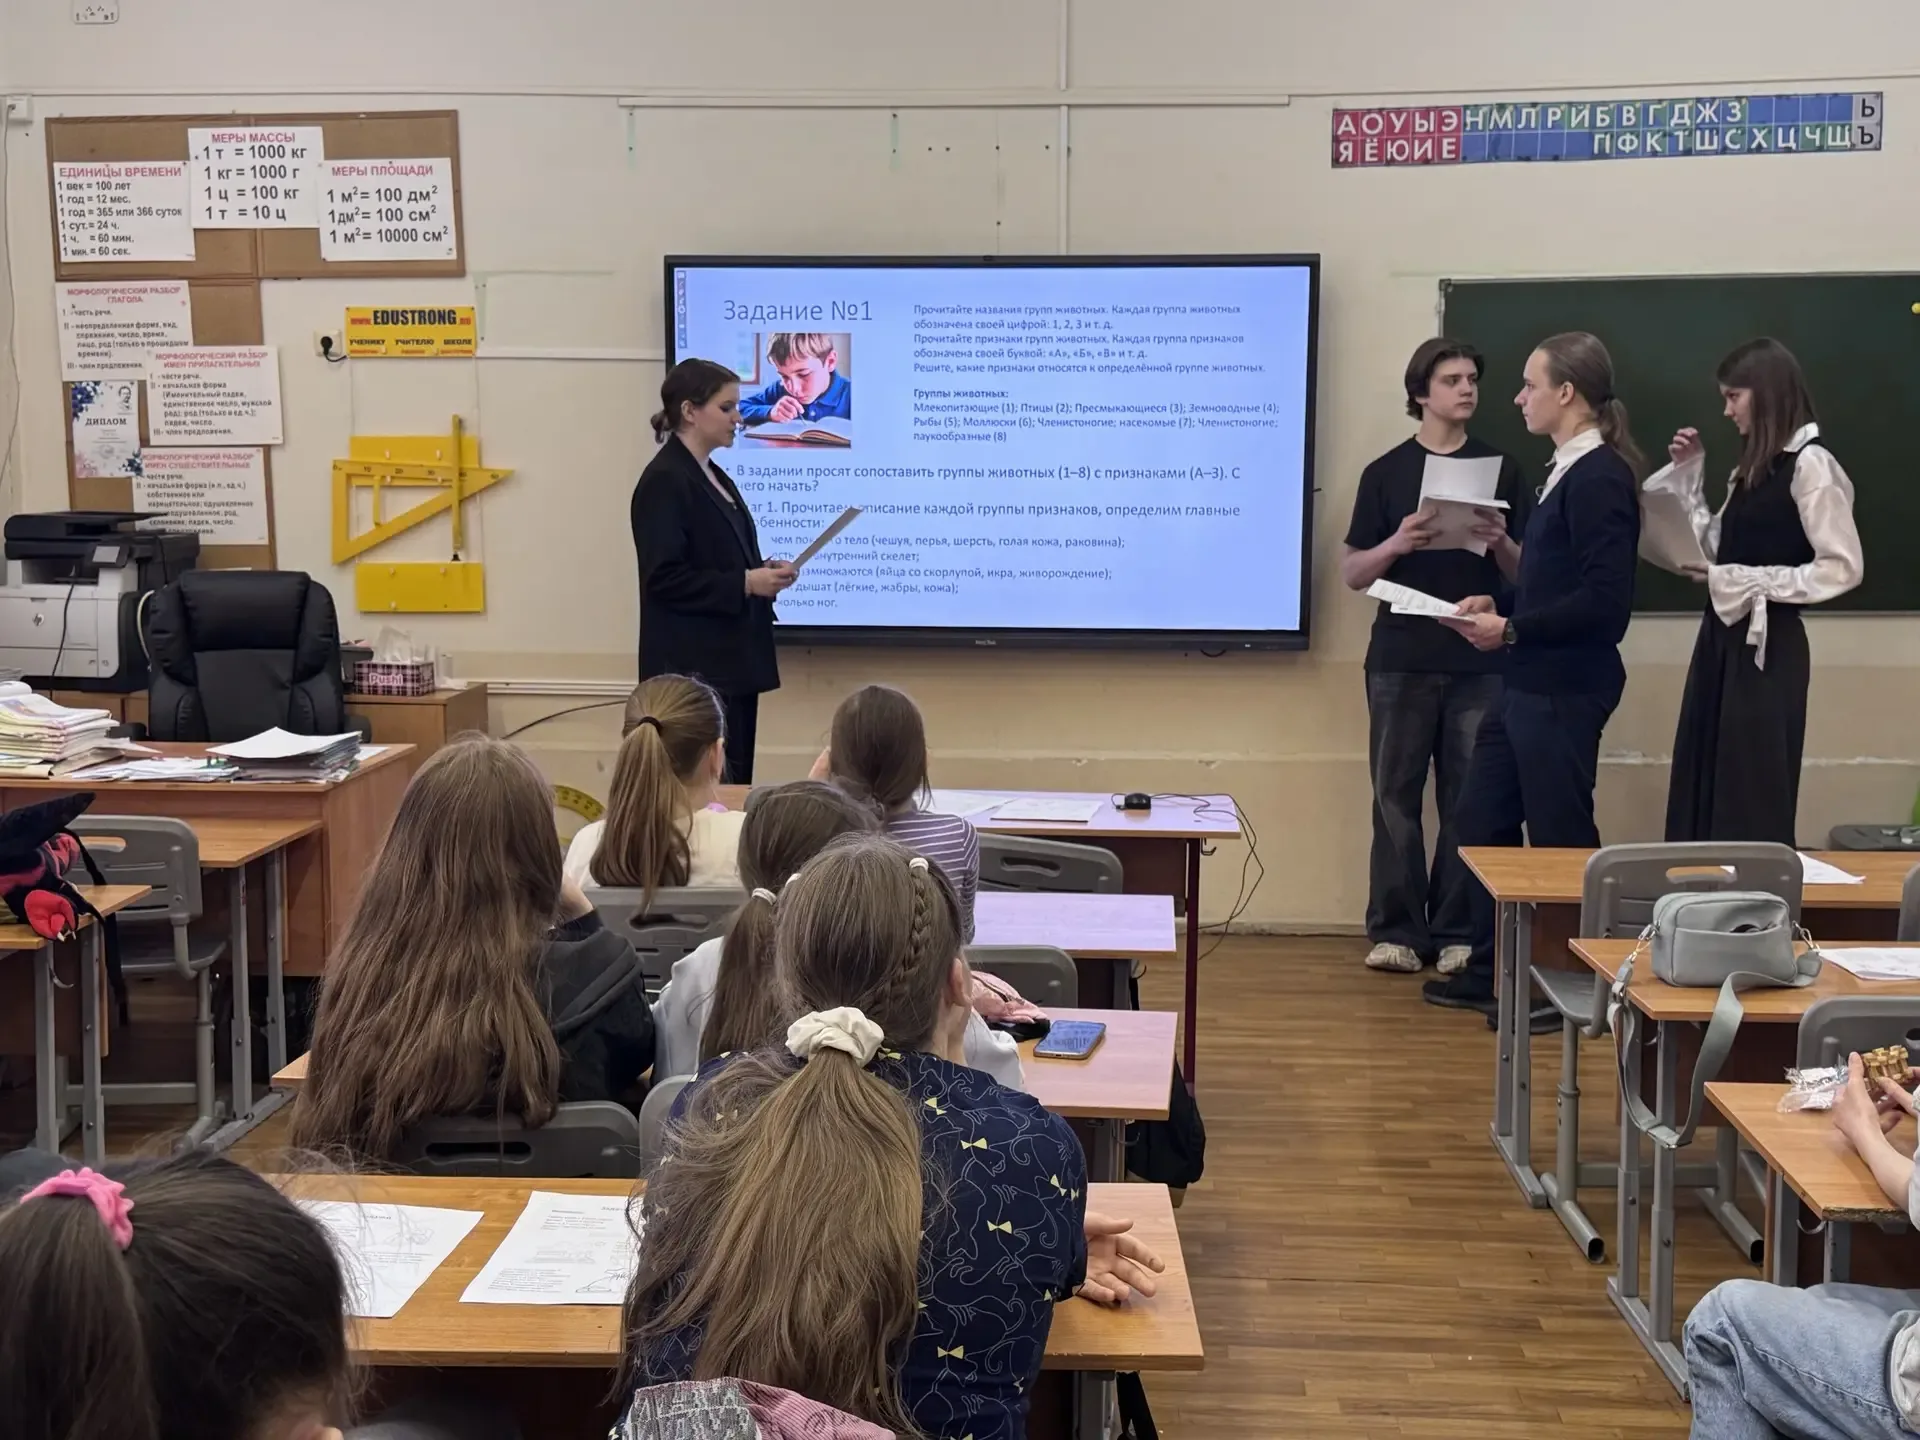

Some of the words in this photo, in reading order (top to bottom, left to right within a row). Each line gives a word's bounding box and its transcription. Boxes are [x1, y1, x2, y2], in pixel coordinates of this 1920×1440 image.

[211, 132, 247, 144] МЕРЫ
[248, 131, 296, 144] МАССЫ
[203, 145, 210, 161] 1
[248, 143, 287, 160] 1000
[291, 147, 308, 159] кг
[59, 166, 122, 180] ЕДИНИЦЫ
[124, 166, 182, 178] ВРЕМЕНИ
[203, 165, 211, 181] 1
[217, 168, 233, 181] кг
[249, 163, 288, 180] 1000
[331, 165, 368, 177] МЕРЫ
[370, 165, 434, 177] ПЛОЩАДИ
[65, 182, 85, 191] век
[95, 180, 113, 191] 100
[113, 182, 132, 191] лет
[204, 185, 212, 201] 1
[251, 184, 279, 200] 100
[283, 188, 300, 200] кг
[66, 195, 86, 206] год
[95, 193, 108, 205] 12
[109, 195, 131, 204] мес.
[326, 188, 335, 204] 1
[375, 187, 403, 203] 100
[67, 208, 87, 219] год
[95, 206, 115, 218] 365
[115, 208, 135, 217] или
[136, 205, 154, 217] 366
[155, 207, 183, 219] суток
[205, 205, 213, 221] 1
[252, 204, 271, 220] 10
[376, 207, 404, 223] 100
[96, 220, 109, 231] 24
[97, 232, 110, 244] 60
[111, 235, 135, 243] мин.
[329, 229, 337, 244] 1
[376, 228, 419, 243] 10000
[97, 245, 110, 257] 60
[111, 247, 131, 257] сек.
[149, 286, 181, 295] РАЗБОР
[724, 299, 823, 325] Задание
[914, 303, 973, 317] Прочитайте
[975, 305, 1023, 315] названия
[1024, 303, 1053, 317] групп
[1056, 305, 1109, 315] животных.
[1112, 304, 1151, 317] Каждая
[1153, 303, 1187, 317] группа
[1190, 305, 1241, 315] животных
[372, 309, 457, 326] EDUSTRONG
[914, 318, 973, 330] обозначена
[975, 319, 1005, 330] своей
[1007, 318, 1051, 332] цифрой:
[914, 333, 973, 345] Прочитайте
[975, 335, 1024, 346] признаки
[1024, 335, 1054, 347] групп
[1056, 335, 1111, 345] животных.
[1112, 333, 1151, 345] Каждая
[1153, 335, 1188, 347] группа
[1190, 335, 1245, 345] признаков
[237, 351, 268, 360] РАЗБОР
[914, 347, 973, 359] обозначена
[975, 347, 1005, 361] своей
[1007, 347, 1047, 361] буквой:
[914, 362, 955, 374] Решите,
[956, 364, 986, 373] какие
[988, 364, 1036, 375] признаки
[1038, 363, 1088, 373] относятся
[1098, 362, 1173, 375] определённой
[1175, 363, 1210, 375] группе
[1212, 364, 1266, 373] животных.
[913, 388, 951, 401] Группы
[953, 389, 1009, 400] животных:
[913, 402, 1000, 415] Млекопитающие
[1021, 402, 1054, 415] Птицы
[1075, 402, 1168, 415] Пресмыкающиеся
[1188, 403, 1261, 415] Земноводные
[84, 417, 127, 427] ДИПЛОМ
[913, 416, 943, 429] Рыбы
[963, 416, 1017, 428] Моллюски
[1038, 416, 1117, 429] Членистоногие;
[1120, 419, 1177, 428] насекомые
[1198, 417, 1279, 429] Членистоногие;
[914, 430, 992, 443] паукообразные
[993, 431, 1008, 444] (8)
[737, 464, 745, 477] В
[748, 466, 803, 479] задании
[807, 467, 852, 481] просят
[854, 467, 935, 480] сопоставить
[938, 467, 985, 481] группы
[988, 467, 1055, 479] животных
[1105, 468, 1187, 481] признаками
[1232, 466, 1241, 480] С
[769, 479, 819, 492] начать?
[782, 501, 848, 515] Прочитае
[924, 502, 975, 517] каждой
[978, 505, 1025, 518] группы
[1028, 505, 1103, 518] признаков,
[1106, 505, 1182, 519] определим
[1186, 505, 1241, 517] главные
[771, 535, 793, 545] чем
[844, 535, 870, 545] тело
[871, 534, 913, 548] (чешуя,
[916, 535, 951, 549] перья,
[954, 537, 997, 549] шерсть,
[999, 537, 1029, 549] голая
[1032, 537, 1063, 549] кожа,
[1065, 535, 1125, 549] раковина);
[880, 551, 920, 564] скелет;
[876, 566, 907, 579] (яйца
[923, 567, 985, 581] скорлупой,
[988, 569, 1017, 581] икра,
[1020, 567, 1113, 581] живорождение);
[794, 580, 833, 593] дышат
[834, 581, 879, 595] (лёгкие,
[881, 581, 921, 596] жабры,
[924, 581, 959, 595] кожа);
